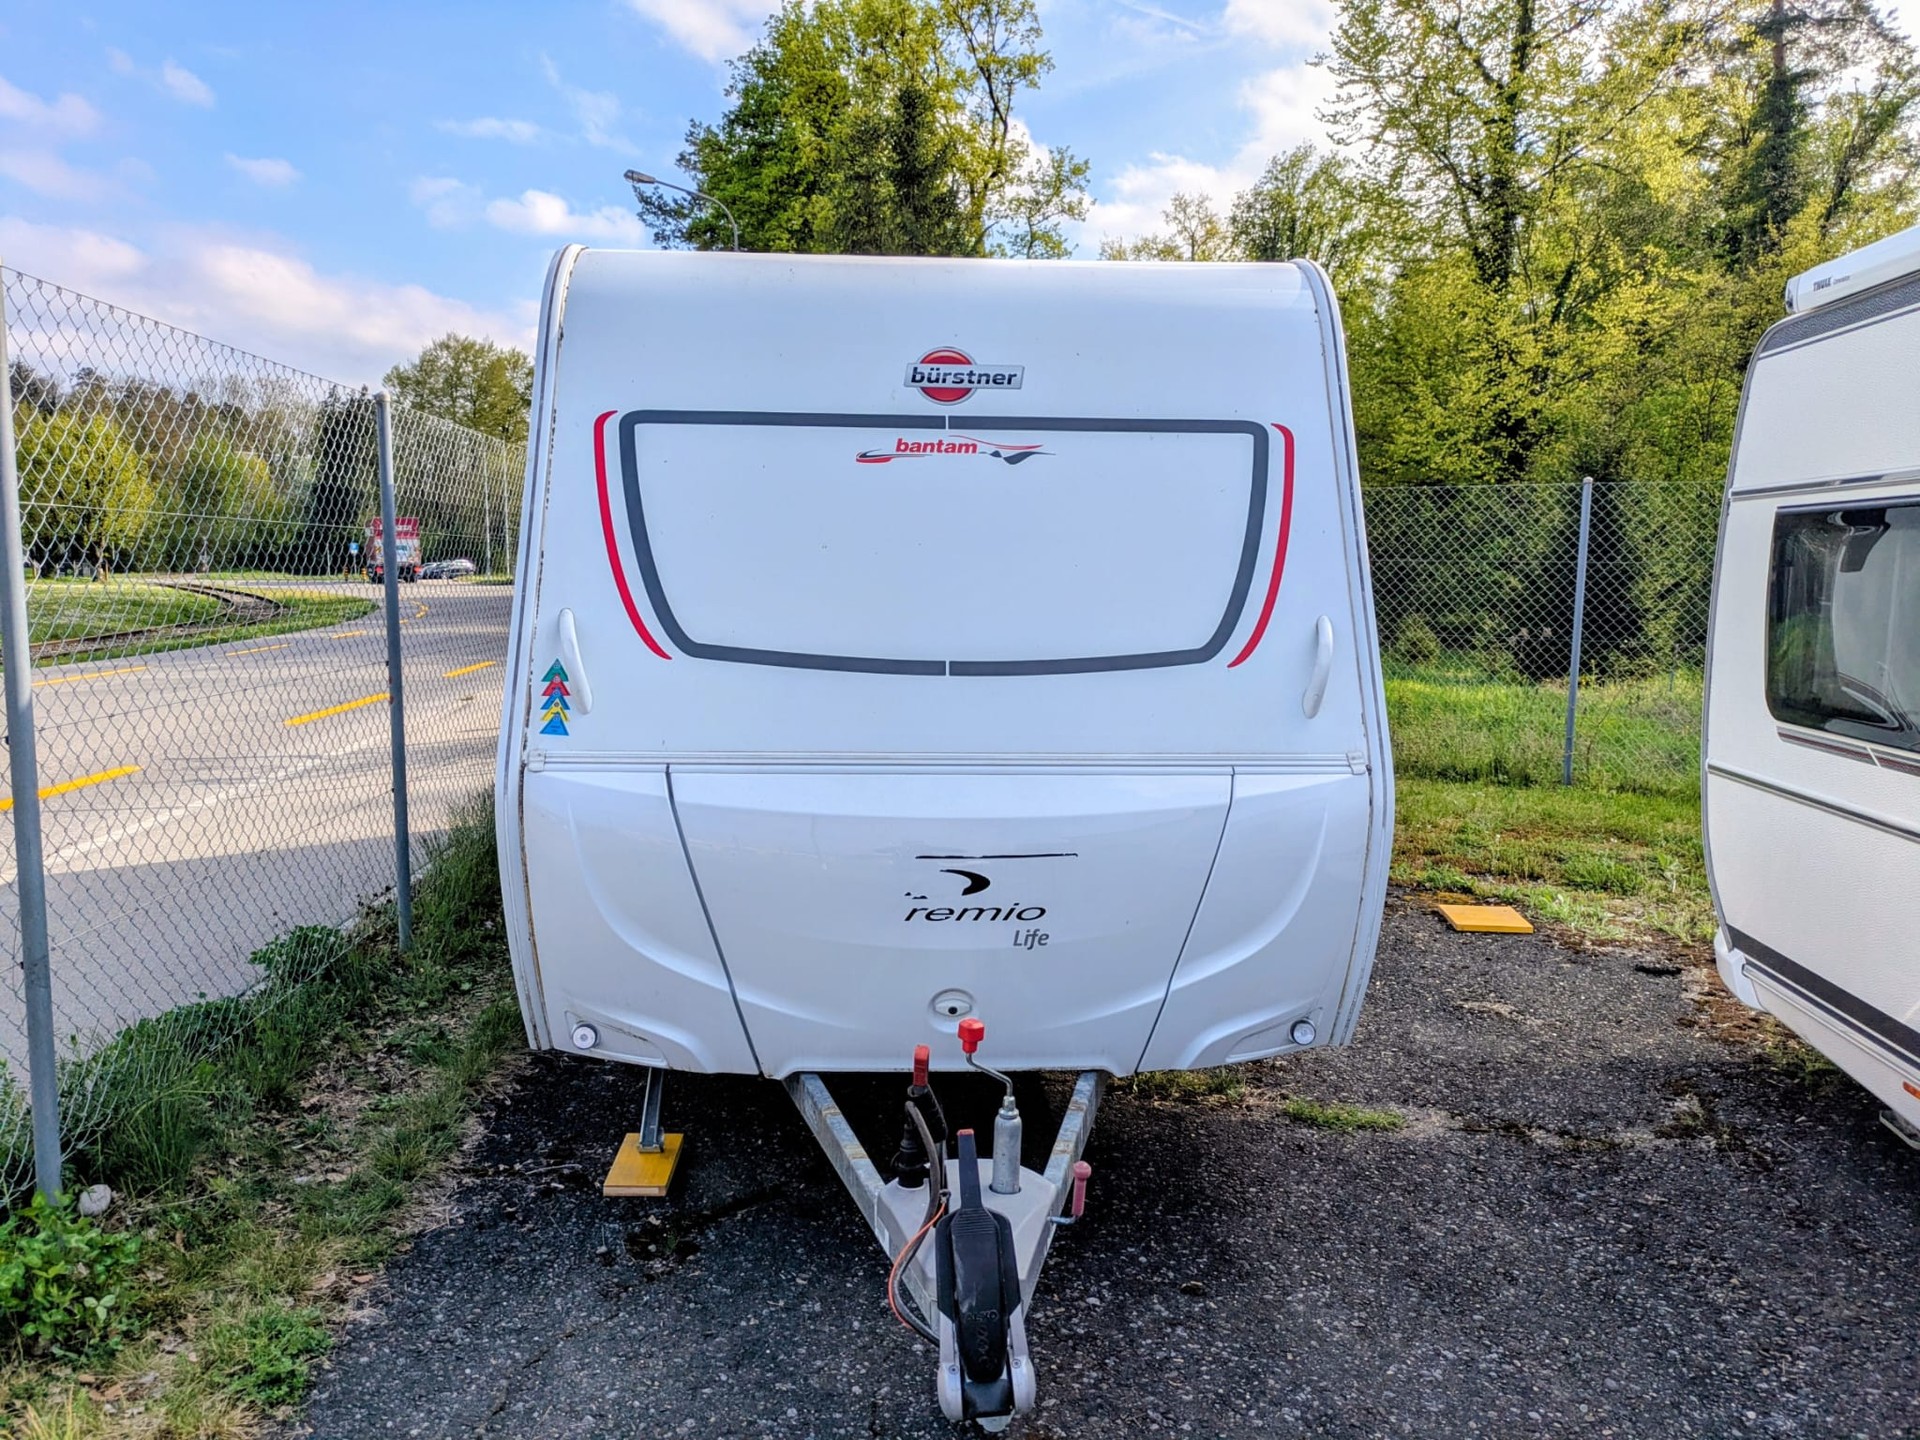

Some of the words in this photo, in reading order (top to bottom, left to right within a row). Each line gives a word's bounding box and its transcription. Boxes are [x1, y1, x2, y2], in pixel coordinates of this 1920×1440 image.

[910, 366, 1017, 386] bürstner
[895, 438, 978, 454] bantam
[1013, 929, 1050, 950] Life
